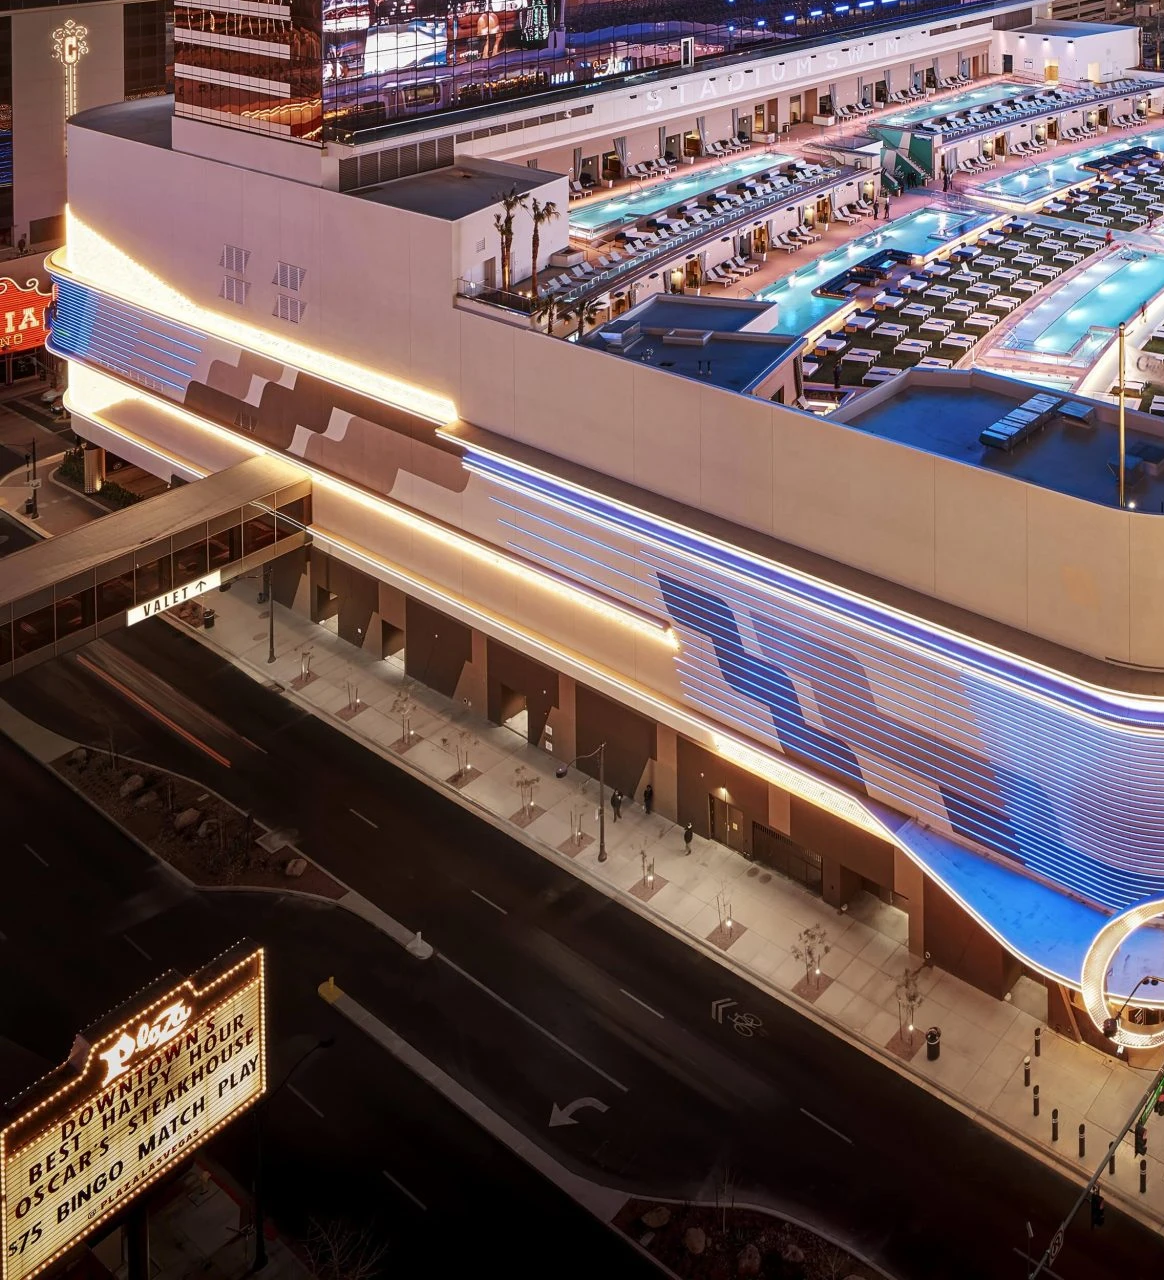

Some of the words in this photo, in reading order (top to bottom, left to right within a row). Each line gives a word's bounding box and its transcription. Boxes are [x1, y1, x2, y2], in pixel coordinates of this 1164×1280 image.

[645, 58, 813, 111] STADIUM
[826, 38, 900, 68] SWIM
[143, 587, 189, 617] VALET
[29, 1132, 82, 1186] BEST
[101, 1066, 172, 1130] HAPPY
[189, 1013, 245, 1065] HOUR
[60, 1016, 216, 1142] DOWNTOWN'S
[100, 999, 192, 1088] Plaza
[8, 1221, 42, 1257] $75
[57, 1160, 123, 1224] BINGO
[138, 1096, 205, 1161] MATCH
[218, 1054, 259, 1099] PLAY
[15, 1136, 110, 1219] OSCAR'S
[128, 1027, 255, 1136] STEAKHOUSE
